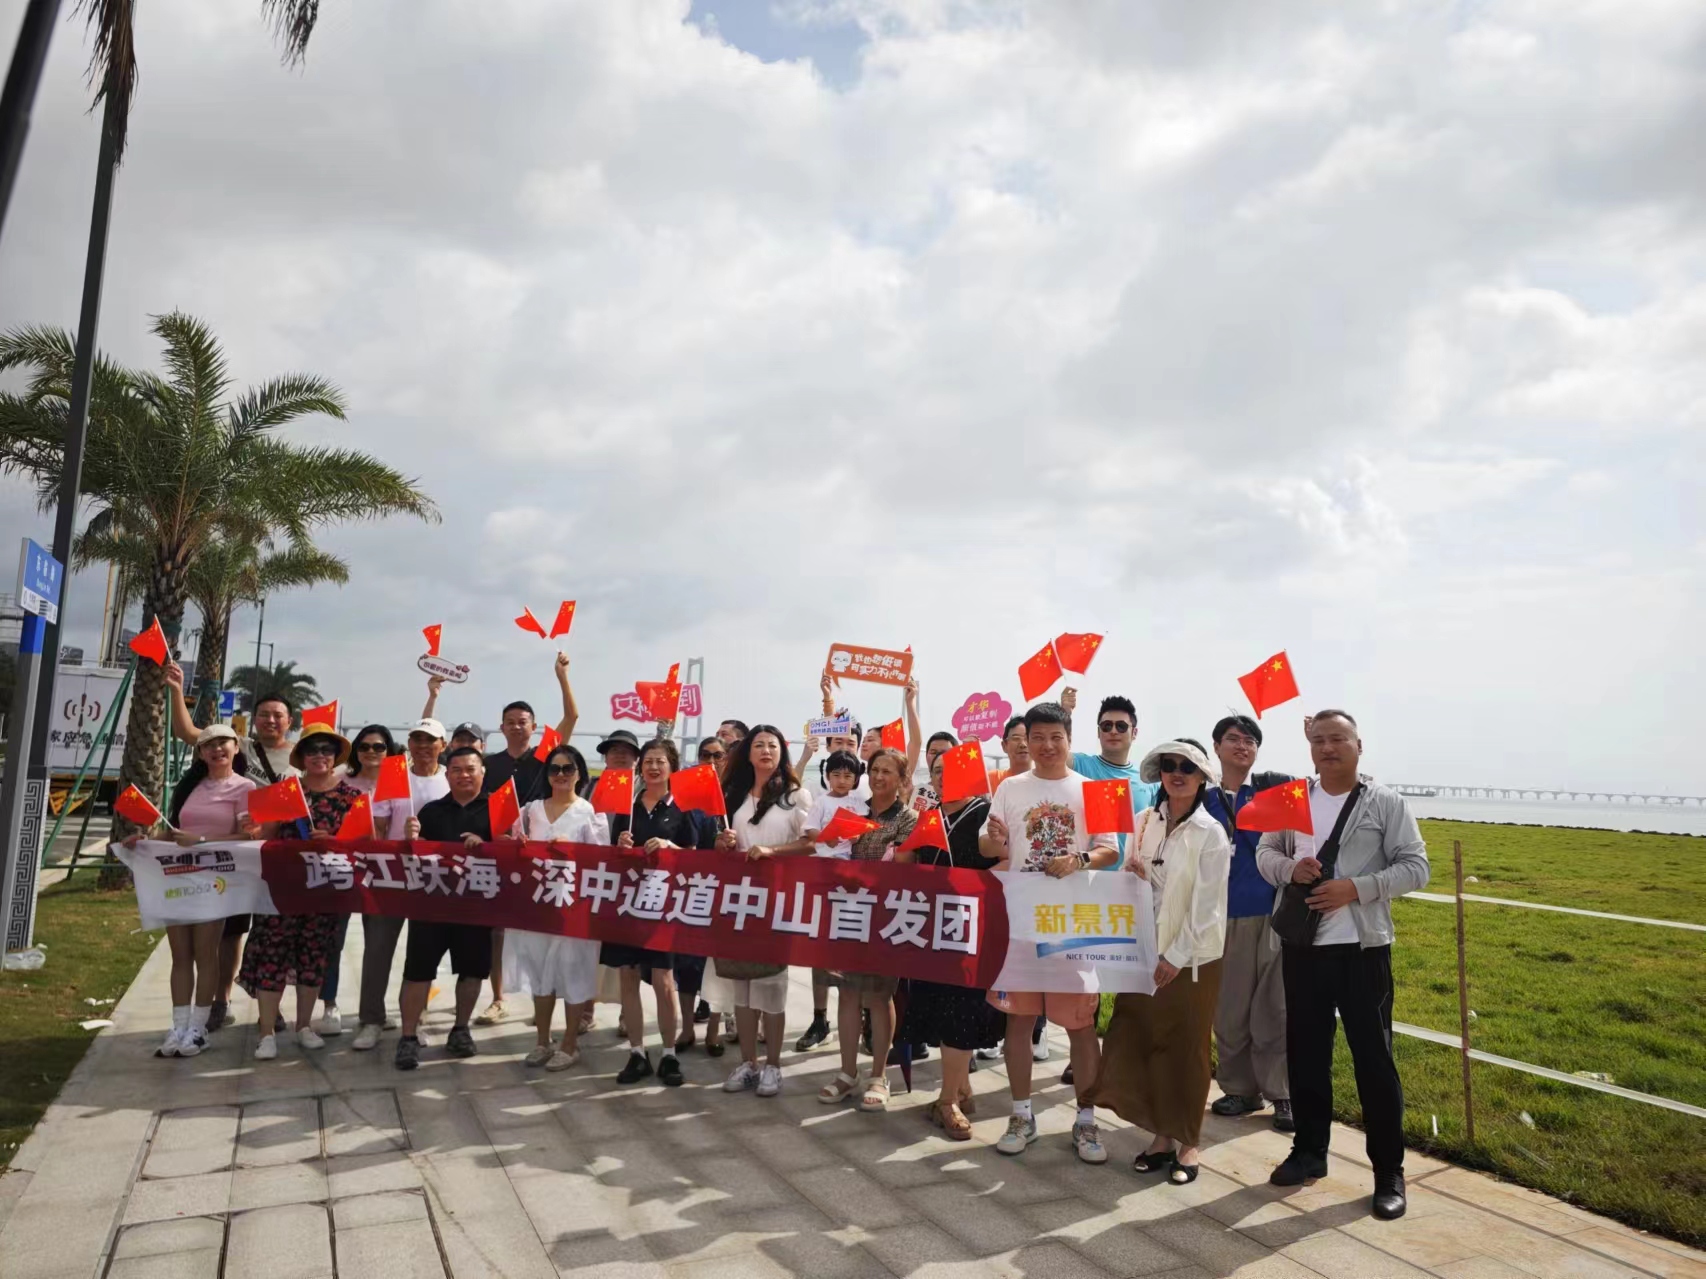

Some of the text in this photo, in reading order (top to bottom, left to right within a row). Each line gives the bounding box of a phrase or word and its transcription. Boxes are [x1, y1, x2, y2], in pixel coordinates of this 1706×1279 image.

[299, 850, 979, 955] 跨江跃海·深中通道中山首发团
[1034, 903, 1137, 936] 新景界
[1065, 953, 1083, 961] NICE
[1086, 953, 1107, 961] TOUR
